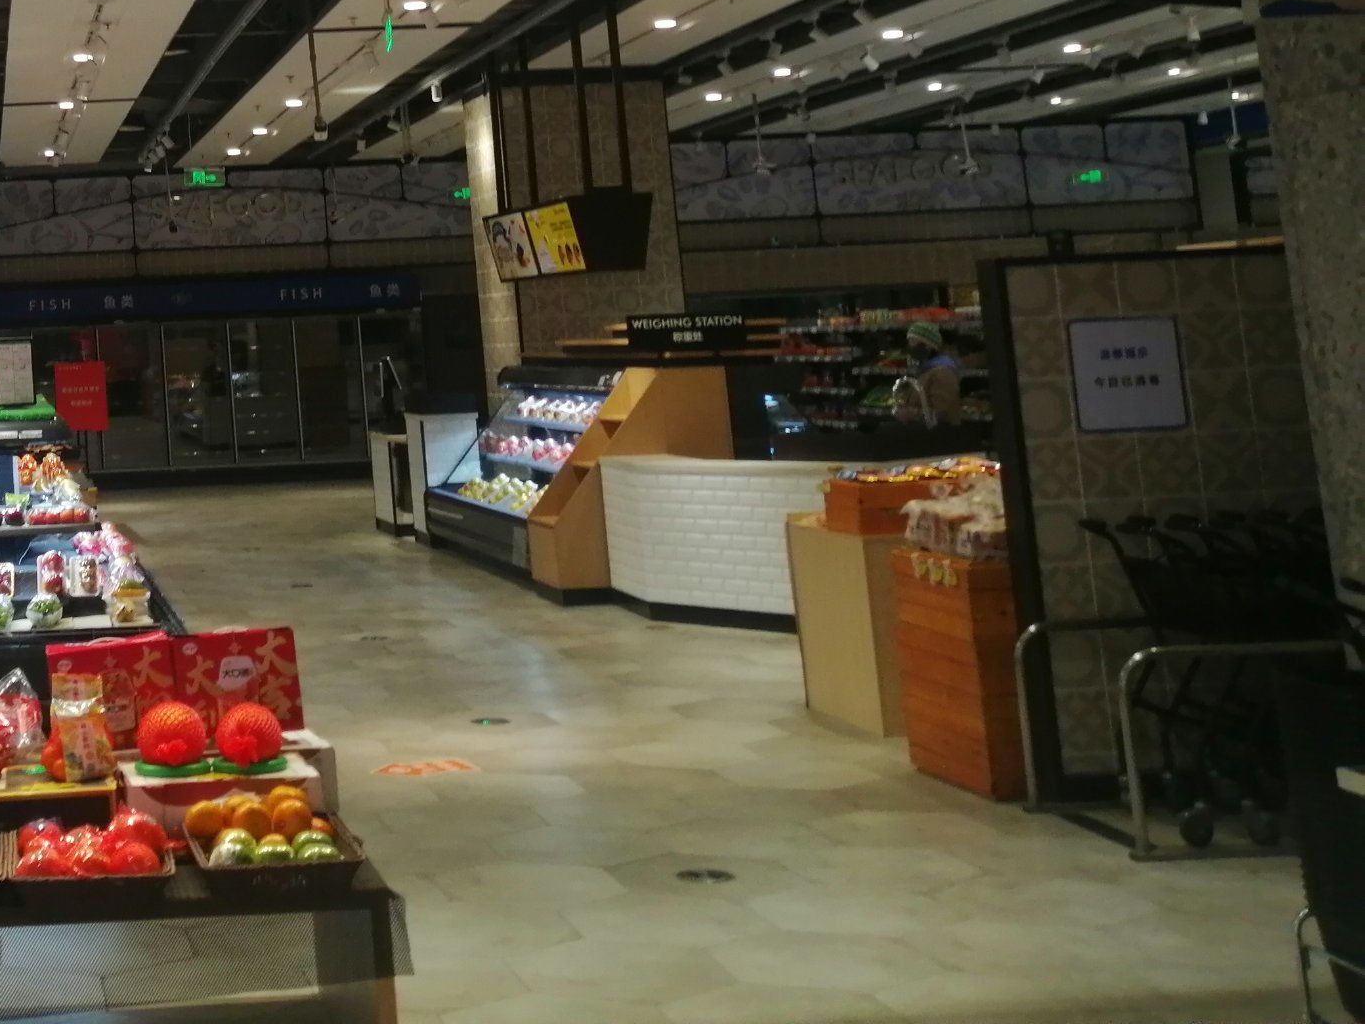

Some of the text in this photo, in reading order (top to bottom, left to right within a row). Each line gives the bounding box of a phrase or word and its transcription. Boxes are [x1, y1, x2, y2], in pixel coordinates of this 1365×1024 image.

[279, 283, 401, 302] FISH 鱼类
[28, 294, 135, 312] FISH 鱼类
[631, 315, 743, 330] WEIGHING STATION
